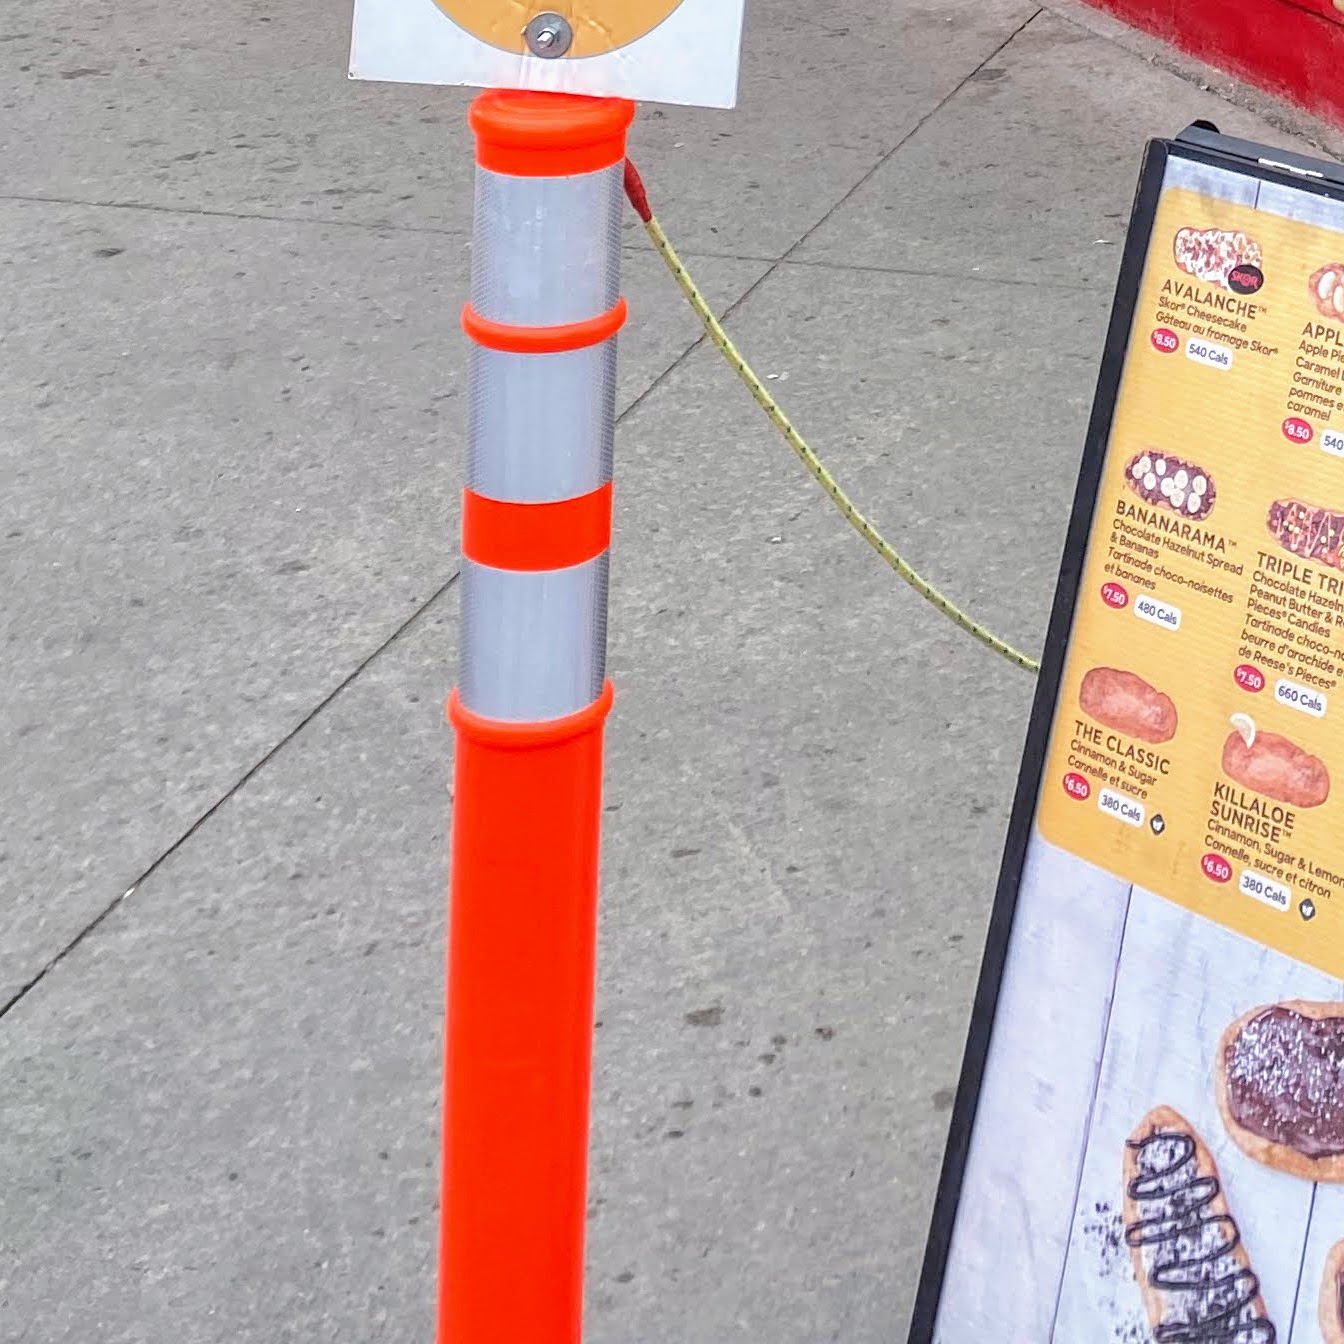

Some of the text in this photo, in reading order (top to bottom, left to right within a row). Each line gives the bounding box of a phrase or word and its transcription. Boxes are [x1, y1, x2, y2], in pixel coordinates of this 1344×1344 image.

[1188, 342, 1228, 365] 540 Cals
[1297, 339, 1329, 358] Apple
[1295, 355, 1341, 379] Caramel
[1323, 434, 1344, 450] 540
[1256, 550, 1313, 585] TRIPLE
[1156, 608, 1177, 625] Cals
[1236, 667, 1261, 689] $7.50
[1277, 684, 1322, 711] 660 Cals
[1074, 719, 1170, 775] THE CLASSIC
[1100, 794, 1140, 821] 380 Cals
[1213, 781, 1295, 829] KILLALOE
[1242, 875, 1286, 905] 380 Cals
